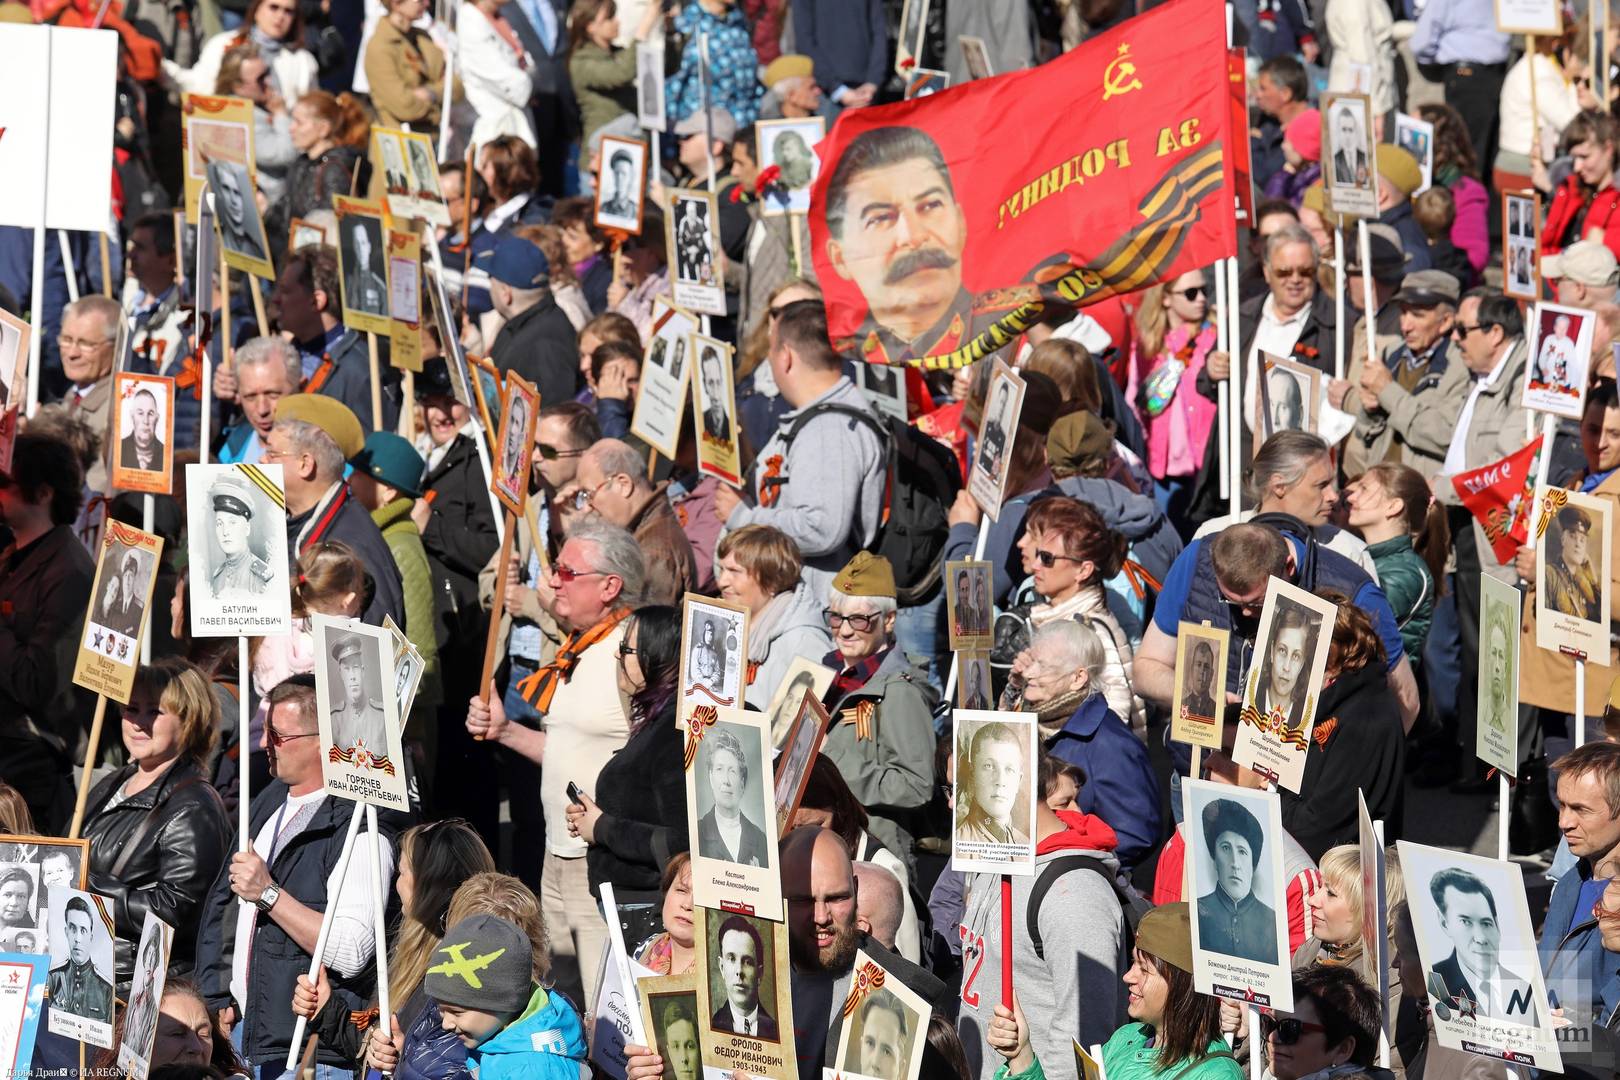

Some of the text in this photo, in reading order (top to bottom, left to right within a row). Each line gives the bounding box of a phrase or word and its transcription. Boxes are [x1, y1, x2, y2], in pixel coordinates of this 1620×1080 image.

[222, 605, 258, 614] БАТУЛИН
[199, 617, 282, 625] ПАВЕЛ ВАСИЛЬЕВИЧ
[346, 773, 382, 790] ГОРЯЧЕВ
[328, 779, 403, 804] ИВАН АРСЕНТЬЕВИЧ
[725, 870, 745, 880] Костина
[712, 877, 760, 892] Елена Александровна
[1227, 964, 1247, 976] Дмитрий
[1248, 968, 1270, 980] Петрович
[731, 1038, 763, 1052] ФРОЛОВ
[714, 1045, 783, 1067] ФЕДОР ИВАНОВИЧ
[732, 1060, 767, 1074] 1903-1943
